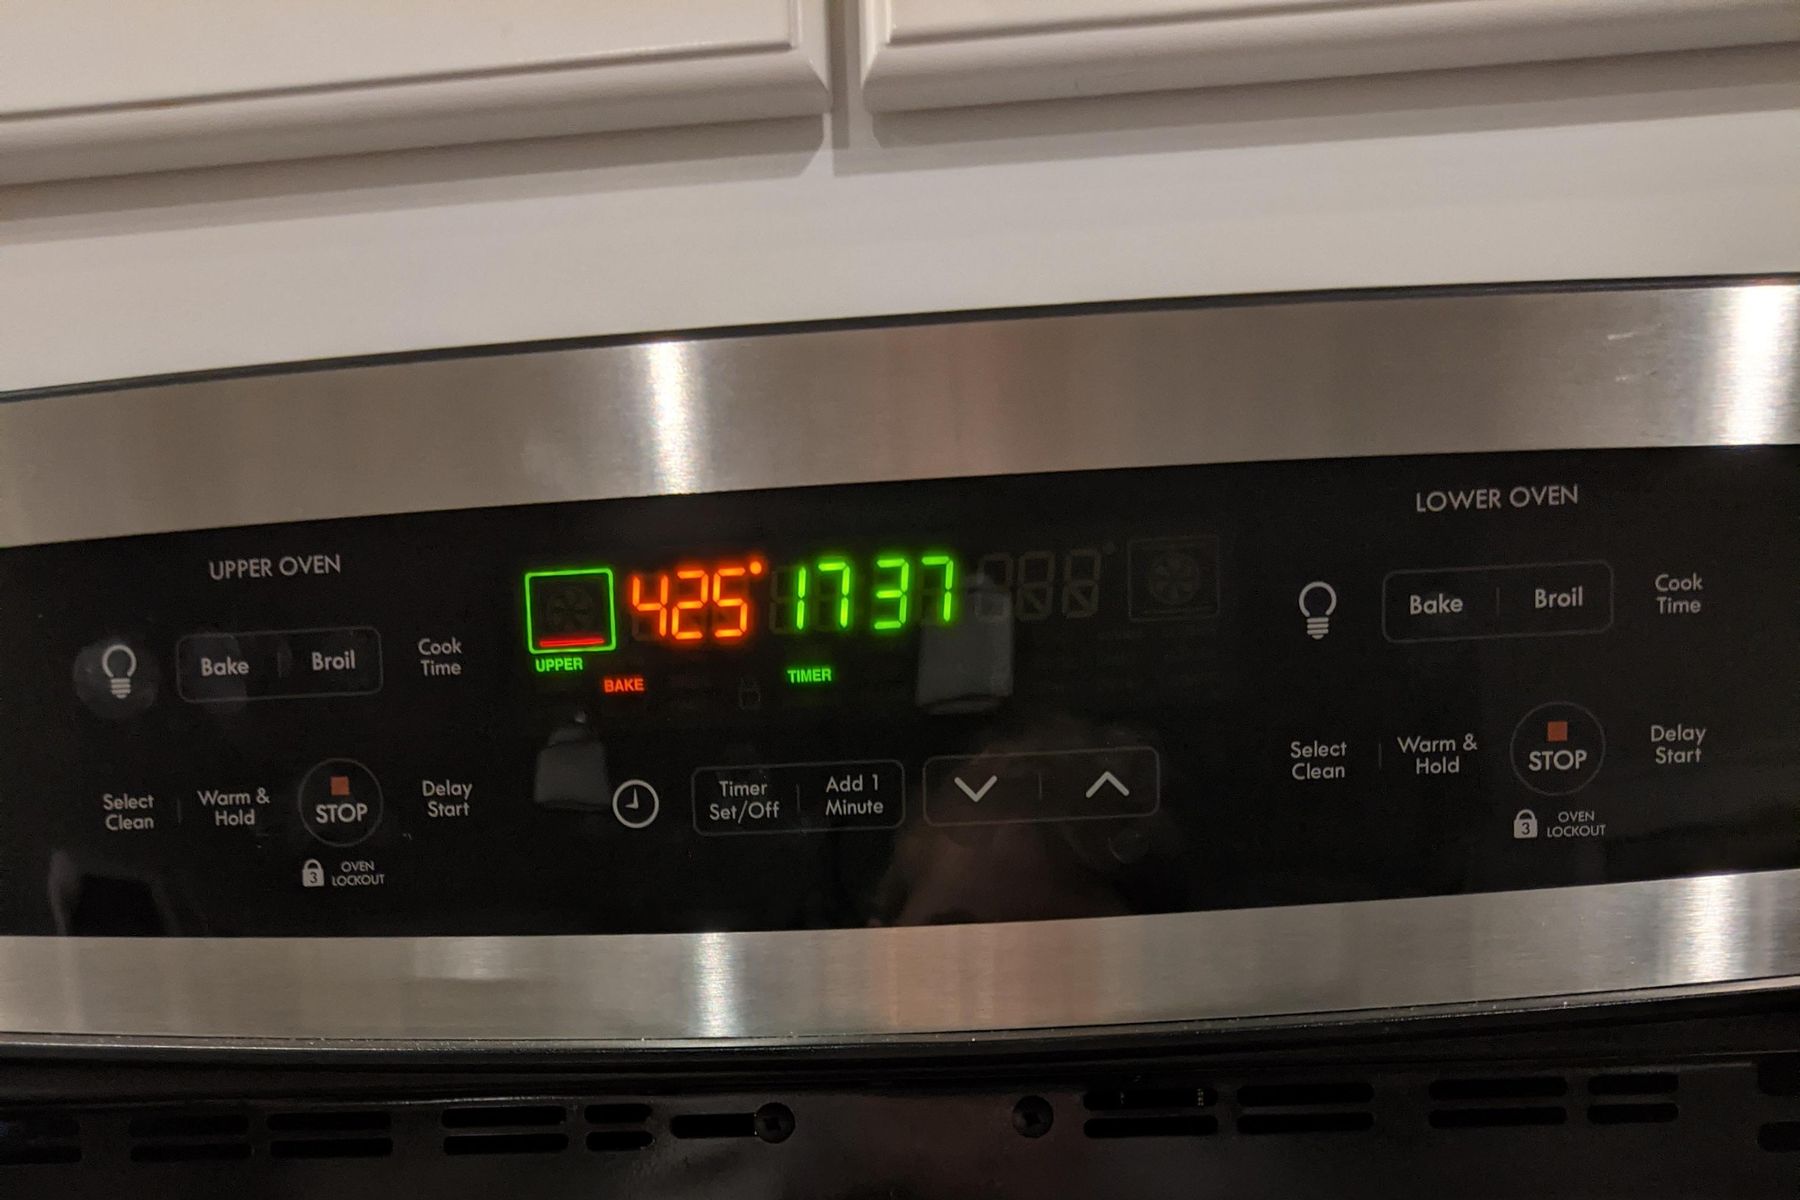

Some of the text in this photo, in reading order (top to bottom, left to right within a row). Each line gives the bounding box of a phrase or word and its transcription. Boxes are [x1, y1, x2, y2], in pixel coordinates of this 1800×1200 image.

[1416, 485, 1578, 513] LOWER OVEN
[209, 553, 341, 581] UPPER OVEN
[1654, 572, 1703, 592] Cook
[1409, 593, 1464, 615] Bake
[1534, 585, 1583, 609] Broil
[1656, 596, 1701, 614] Time
[417, 637, 462, 656] Cook
[200, 656, 250, 677] Bake
[311, 649, 356, 671] Broil
[420, 659, 462, 676] Time
[535, 656, 583, 673] UPPER
[787, 667, 832, 683] TIMER
[603, 677, 644, 693] BAKE
[1397, 732, 1478, 753] Warm &
[1650, 723, 1706, 746] Delay
[1290, 740, 1347, 759] Select
[1655, 746, 1702, 764] Start
[1416, 755, 1460, 775] Hold
[1528, 749, 1588, 771] STOP
[1291, 762, 1345, 780] Clean
[422, 779, 473, 800] Delay
[719, 780, 768, 797] Timer
[825, 773, 878, 793] Add 1
[103, 793, 154, 811] Select
[197, 787, 270, 807] Warm &
[215, 808, 256, 826] Hold
[315, 802, 368, 824] STOP
[427, 800, 470, 818] Start
[709, 800, 780, 824] Set/Off
[825, 799, 884, 816] Minute
[1557, 810, 1595, 823] OVEN
[105, 813, 154, 831] Clean
[1546, 824, 1606, 838] LOCKOUT
[340, 860, 375, 873] OVEN
[331, 873, 385, 887] LOCKOUT
